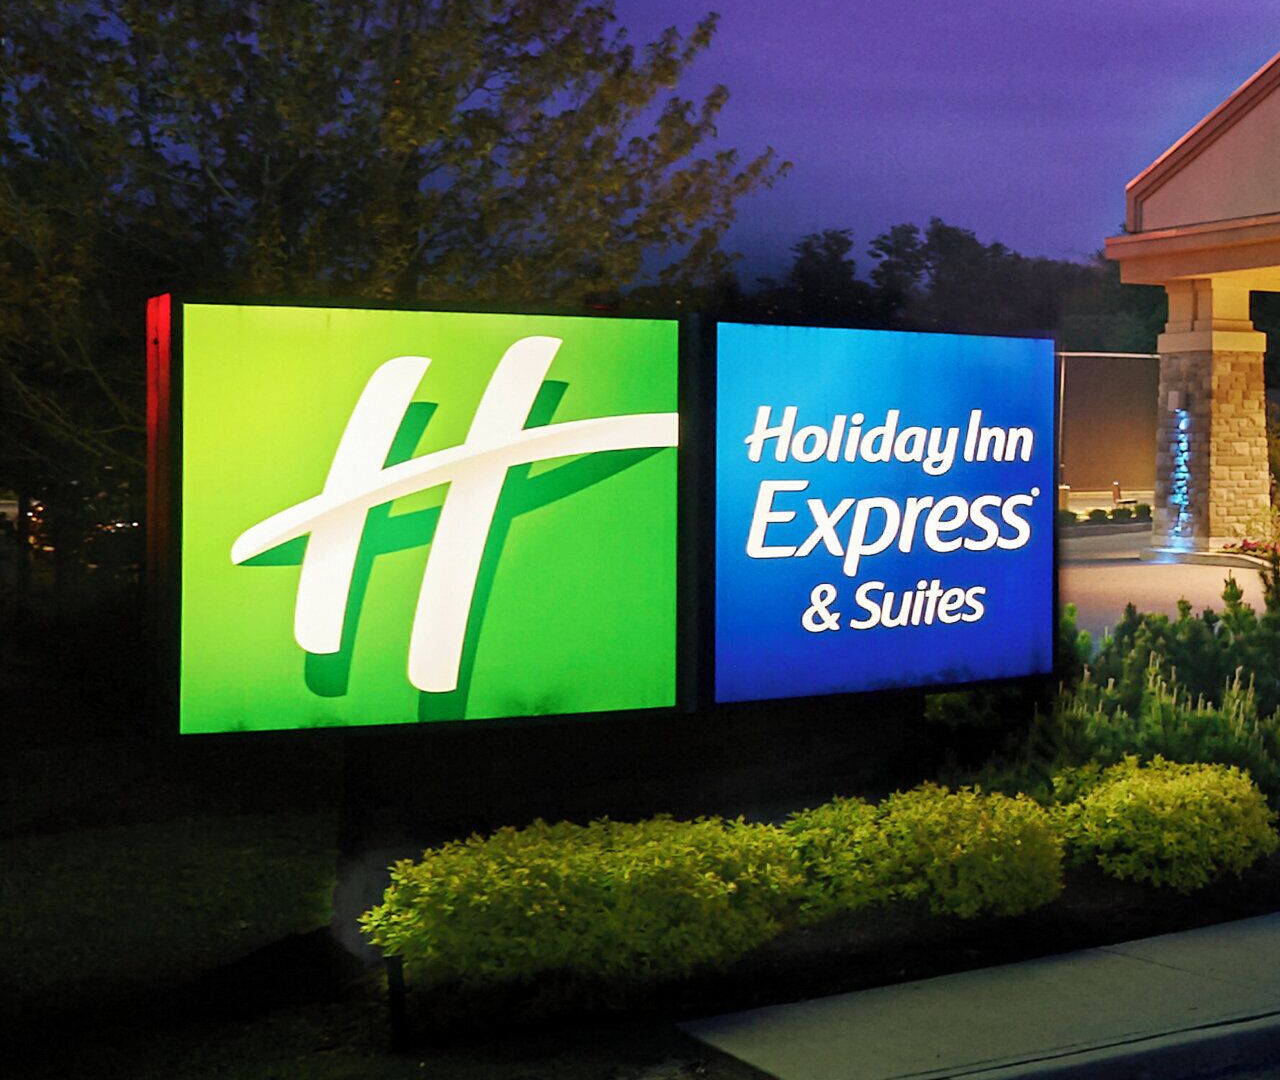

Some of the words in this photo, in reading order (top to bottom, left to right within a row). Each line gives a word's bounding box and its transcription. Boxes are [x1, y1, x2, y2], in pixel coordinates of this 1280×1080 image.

[744, 405, 960, 476] Holiday
[963, 409, 1034, 462] Inn
[746, 479, 1035, 577] Express
[801, 583, 841, 632] &
[850, 579, 987, 630] Suites
